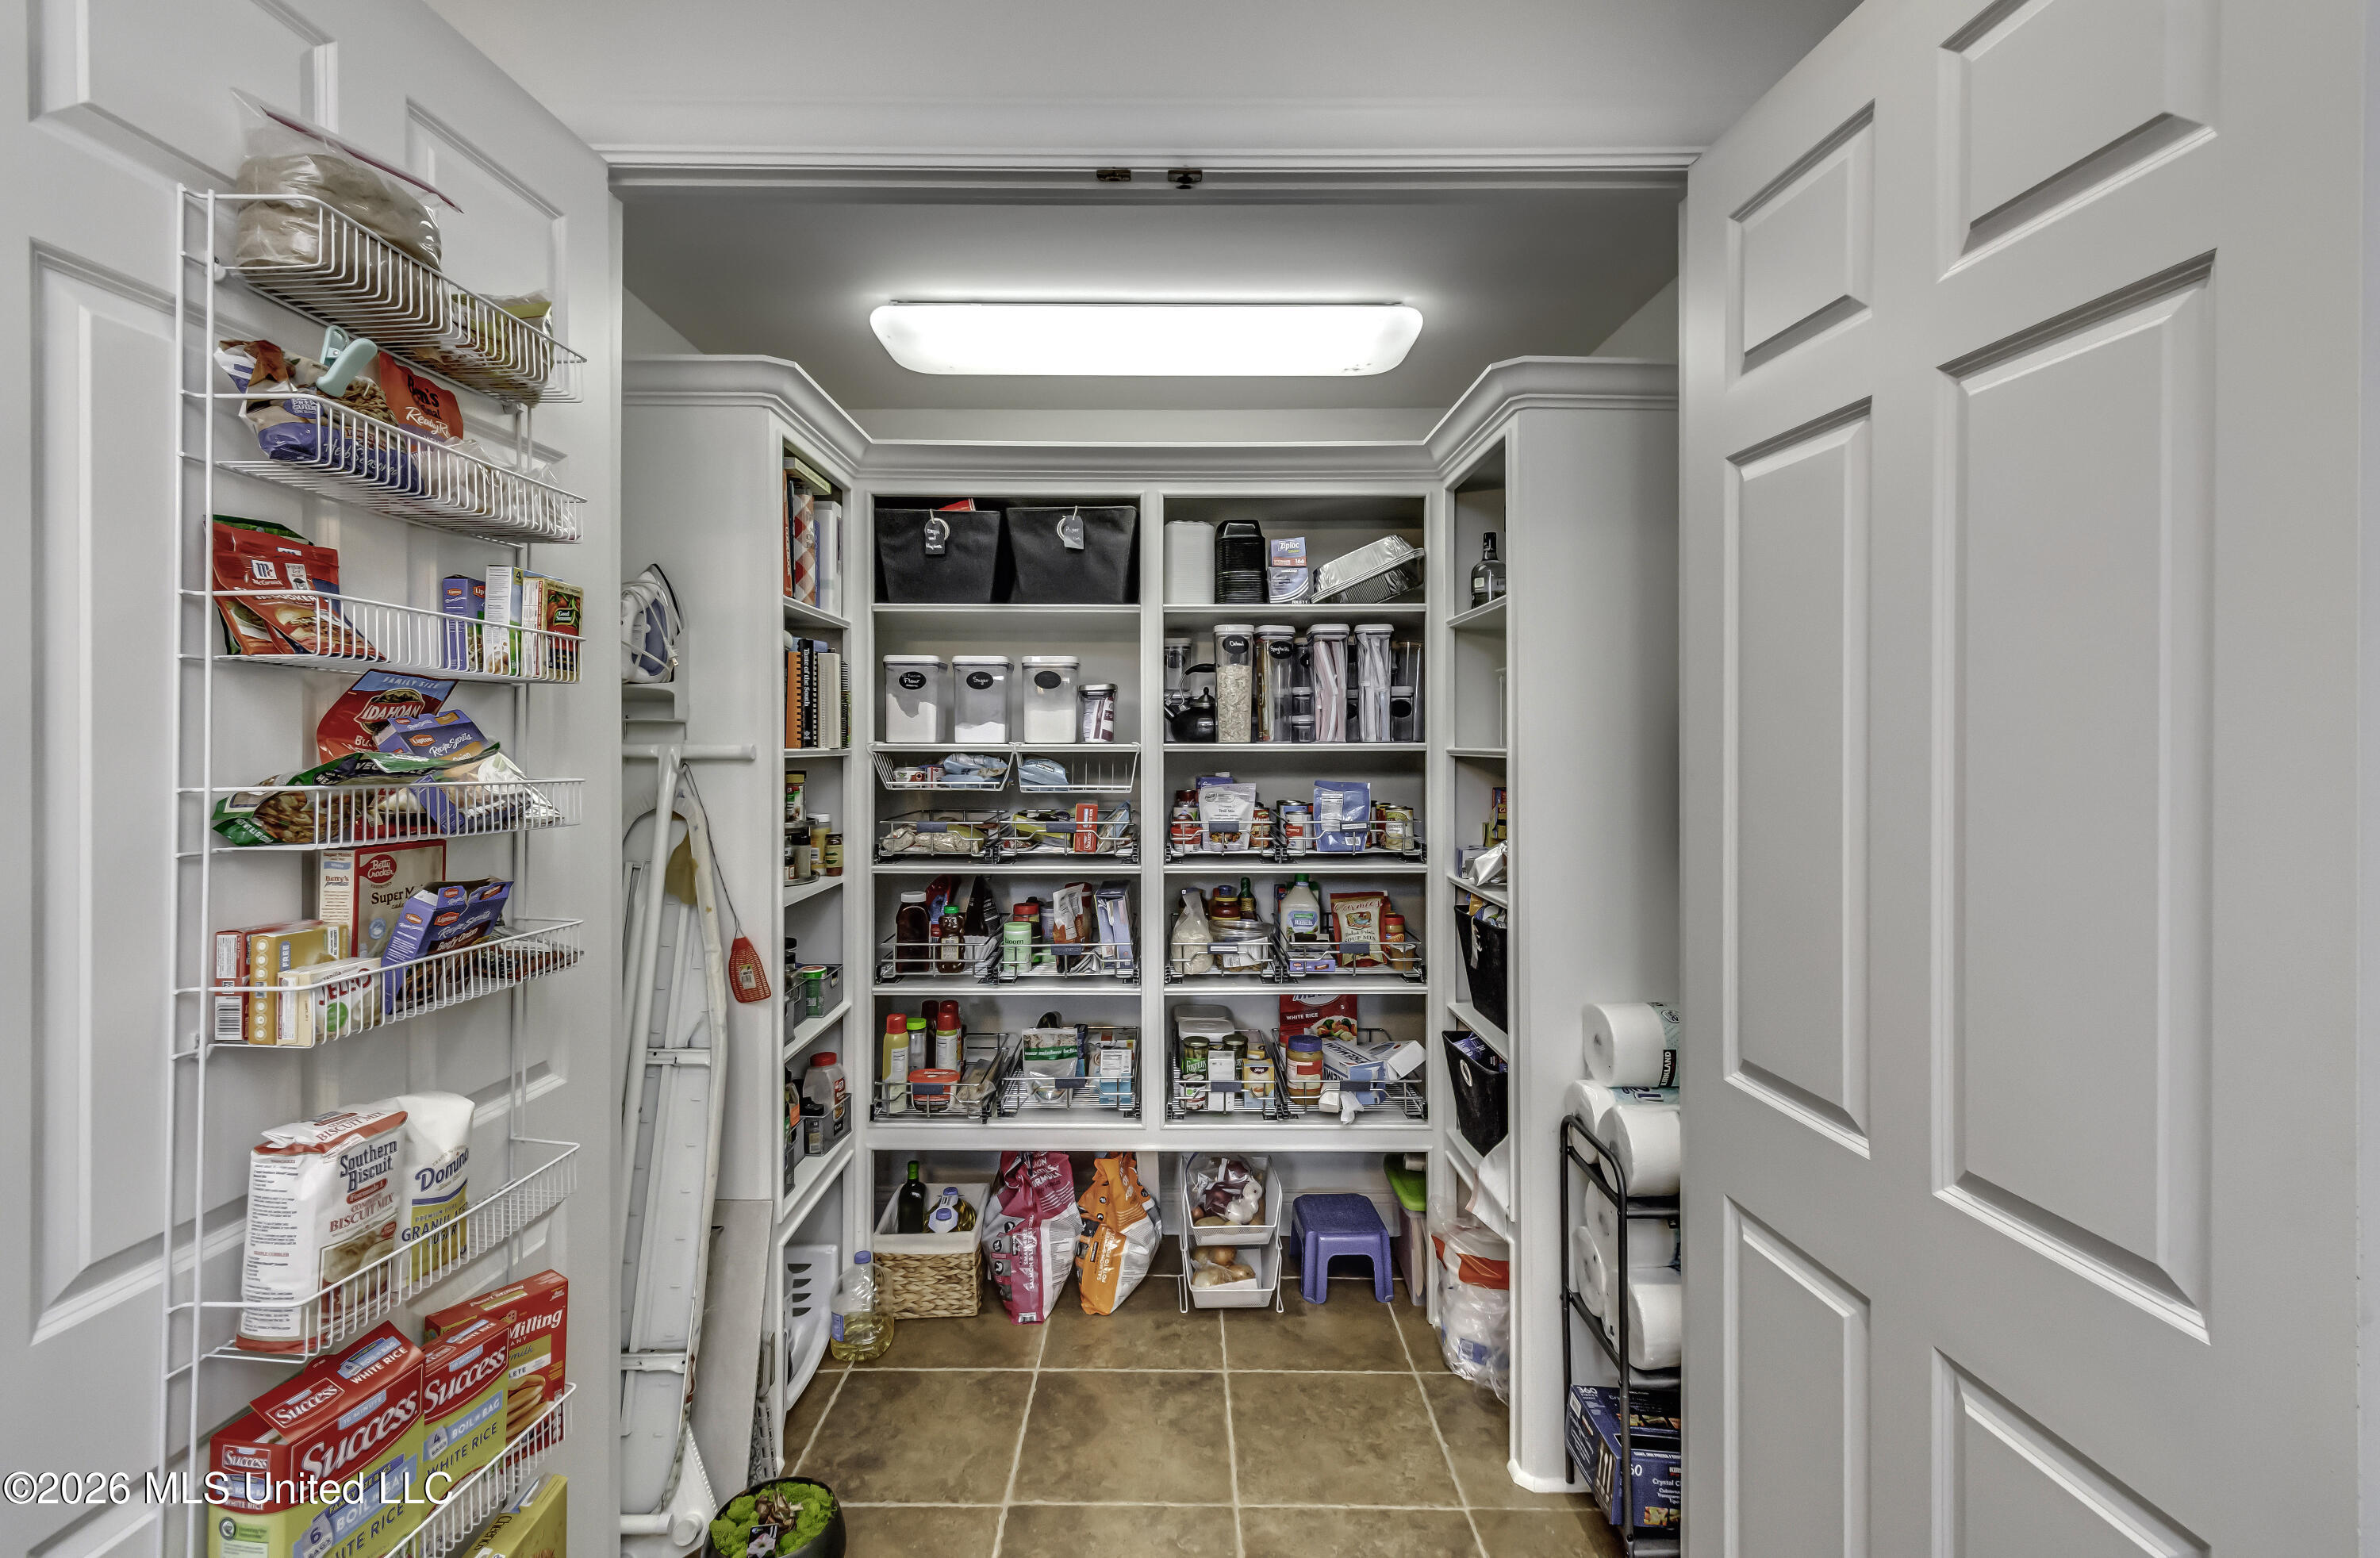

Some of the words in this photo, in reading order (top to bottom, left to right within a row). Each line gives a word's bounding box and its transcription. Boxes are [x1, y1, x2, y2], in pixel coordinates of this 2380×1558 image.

[1279, 541, 1300, 551] Ziploc
[516, 571, 522, 580] 4
[475, 586, 485, 595] Lip
[382, 677, 417, 688] FAMILY
[361, 704, 422, 721] IDAHOAN
[411, 736, 434, 746] Lipton
[367, 869, 395, 879] Crocker
[370, 859, 391, 870] Betty
[370, 891, 405, 906] Super
[436, 915, 459, 923] Lipton
[437, 935, 459, 952] Beefy
[458, 927, 478, 943] Onion
[1660, 1051, 1672, 1086] KIRKLAND
[316, 1118, 363, 1142] BISCUIT
[363, 1111, 386, 1123] MIX
[340, 1140, 397, 1179] Southern
[414, 1148, 470, 1193] Domino
[347, 1155, 393, 1193] Biscuit
[329, 1205, 374, 1234] BISCUIT
[377, 1194, 394, 1211] MIX
[509, 1308, 564, 1340] Milling
[350, 1362, 385, 1384] WHITE
[382, 1345, 409, 1365] RICE
[424, 1345, 507, 1414] Success
[274, 1383, 340, 1425] Success
[451, 1416, 473, 1438] BOIL
[482, 1397, 500, 1418] BAG
[297, 1389, 419, 1493] Success
[427, 1445, 468, 1477] WHITE
[471, 1421, 497, 1449] RICE
[433, 1433, 440, 1444] 4
[224, 1450, 268, 1470] Success
[1630, 1464, 1643, 1477] 60
[1653, 1477, 1674, 1487] Crystal
[336, 1500, 371, 1532] BOIL
[370, 1499, 405, 1539] RICE
[309, 1526, 322, 1545] 6
